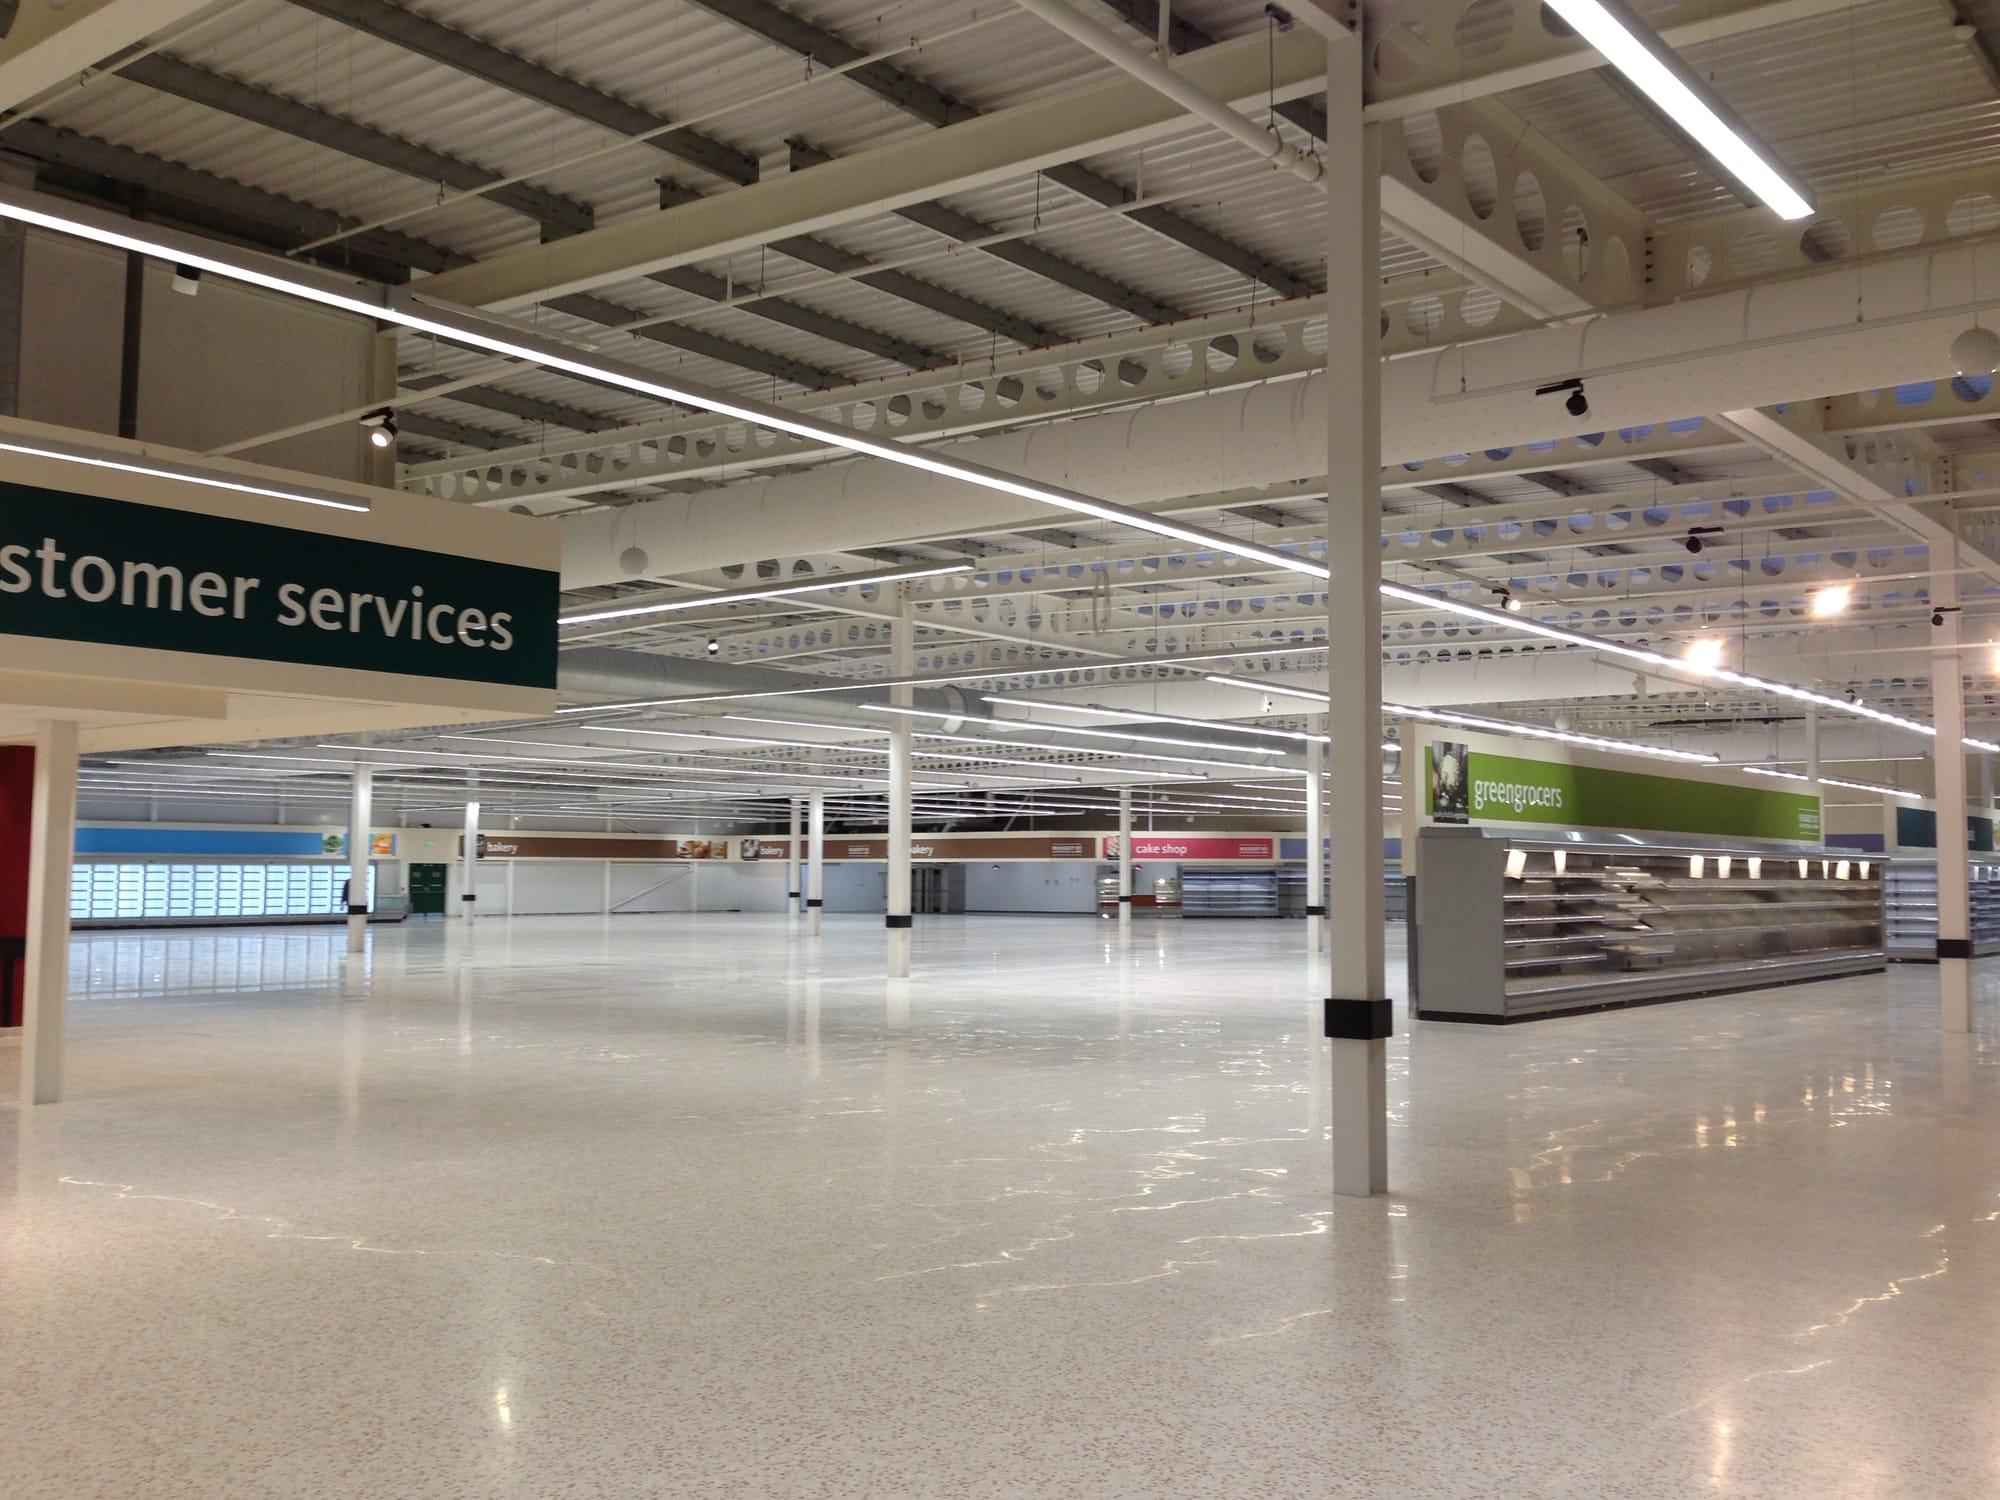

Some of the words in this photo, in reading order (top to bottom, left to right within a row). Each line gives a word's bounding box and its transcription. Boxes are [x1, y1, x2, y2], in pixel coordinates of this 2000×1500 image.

[0, 537, 260, 621] stomer
[276, 582, 515, 652] services
[1474, 780, 1563, 814] greengrocers
[487, 842, 517, 854] bakery
[760, 846, 783, 857] bakery
[911, 844, 934, 856] akery
[1135, 843, 1160, 854] cake
[1161, 843, 1187, 856] shop
